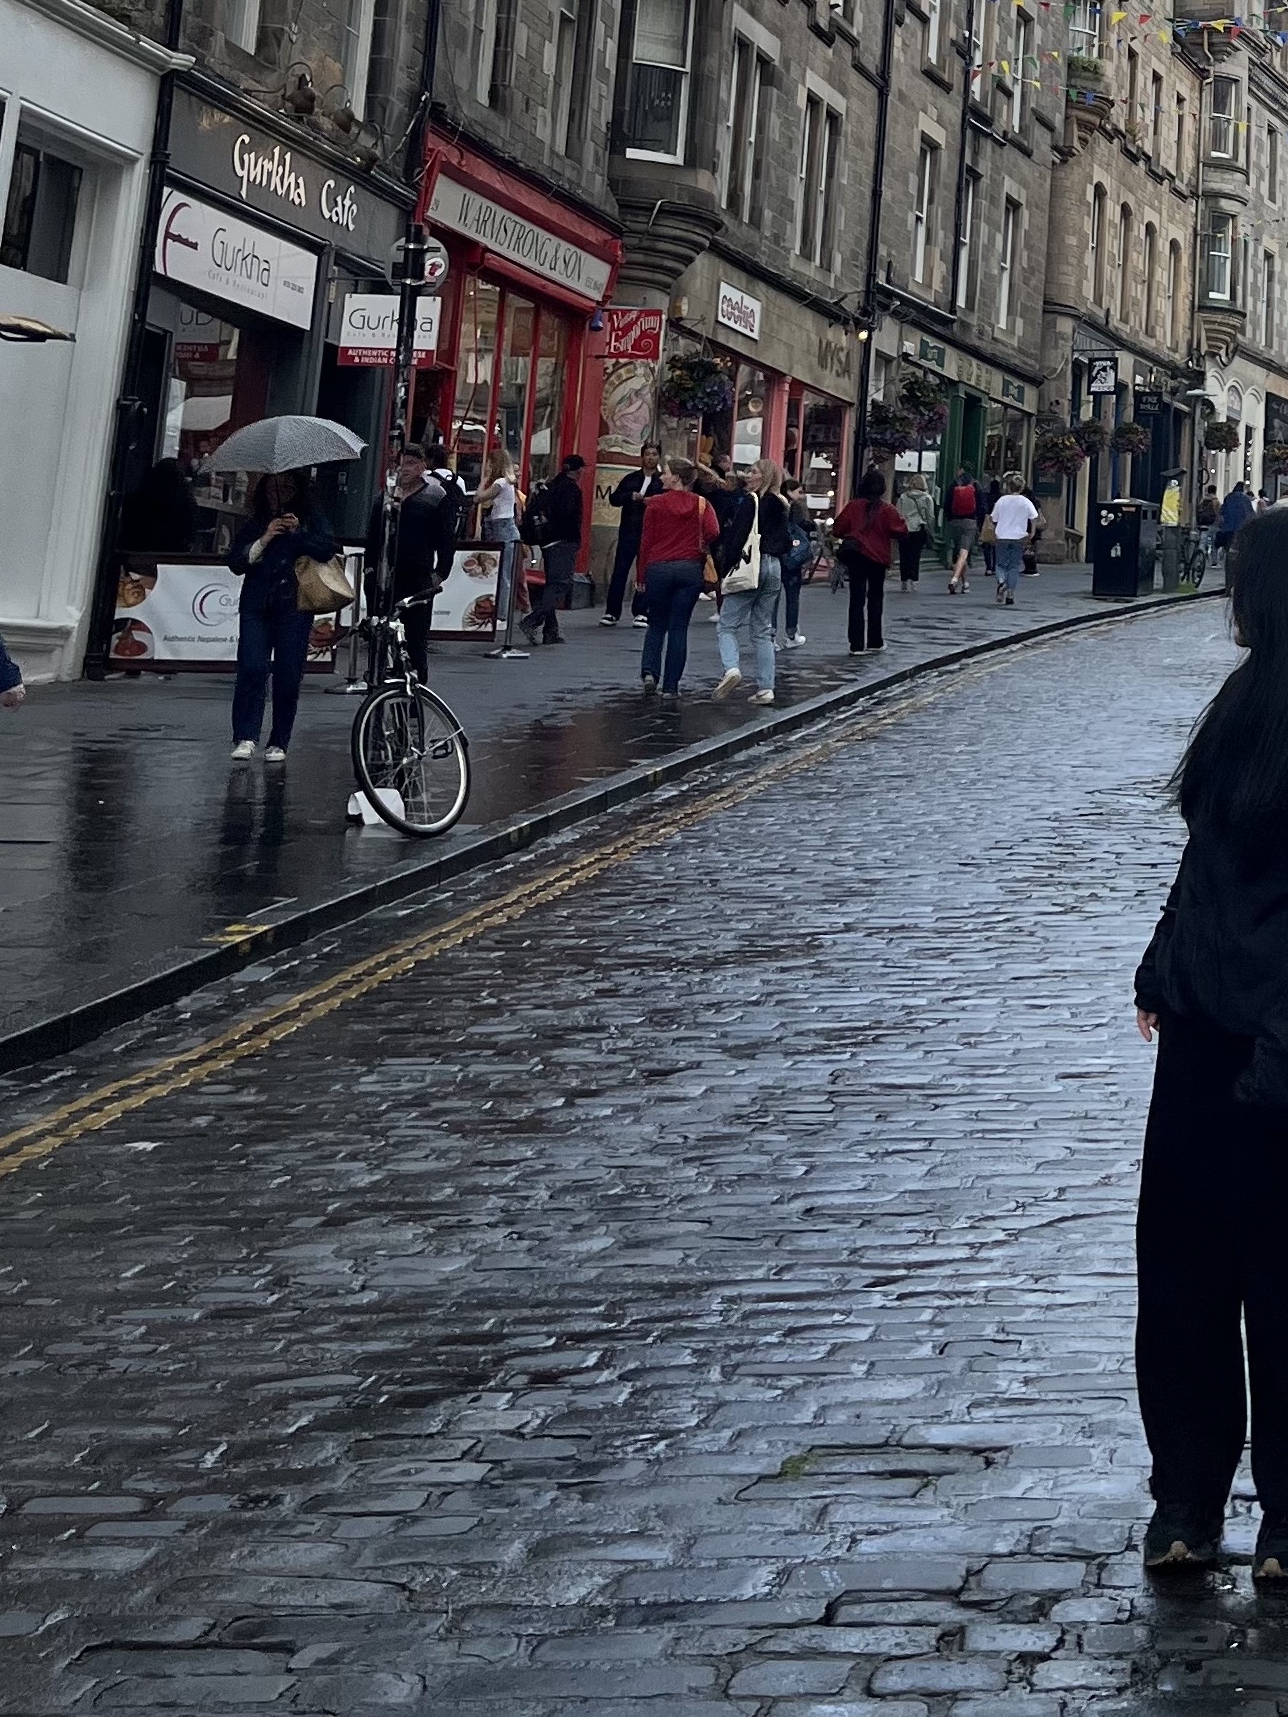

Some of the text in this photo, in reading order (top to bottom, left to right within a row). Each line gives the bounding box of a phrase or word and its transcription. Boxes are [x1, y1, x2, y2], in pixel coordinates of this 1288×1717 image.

[233, 133, 358, 232] Gurkha Cafe
[211, 227, 271, 288] Gurkha
[550, 242, 560, 272] &
[559, 248, 587, 283] SON
[348, 307, 433, 332] Gurka
[347, 348, 389, 357] AUTHENTIC
[361, 356, 388, 364] INDIAN
